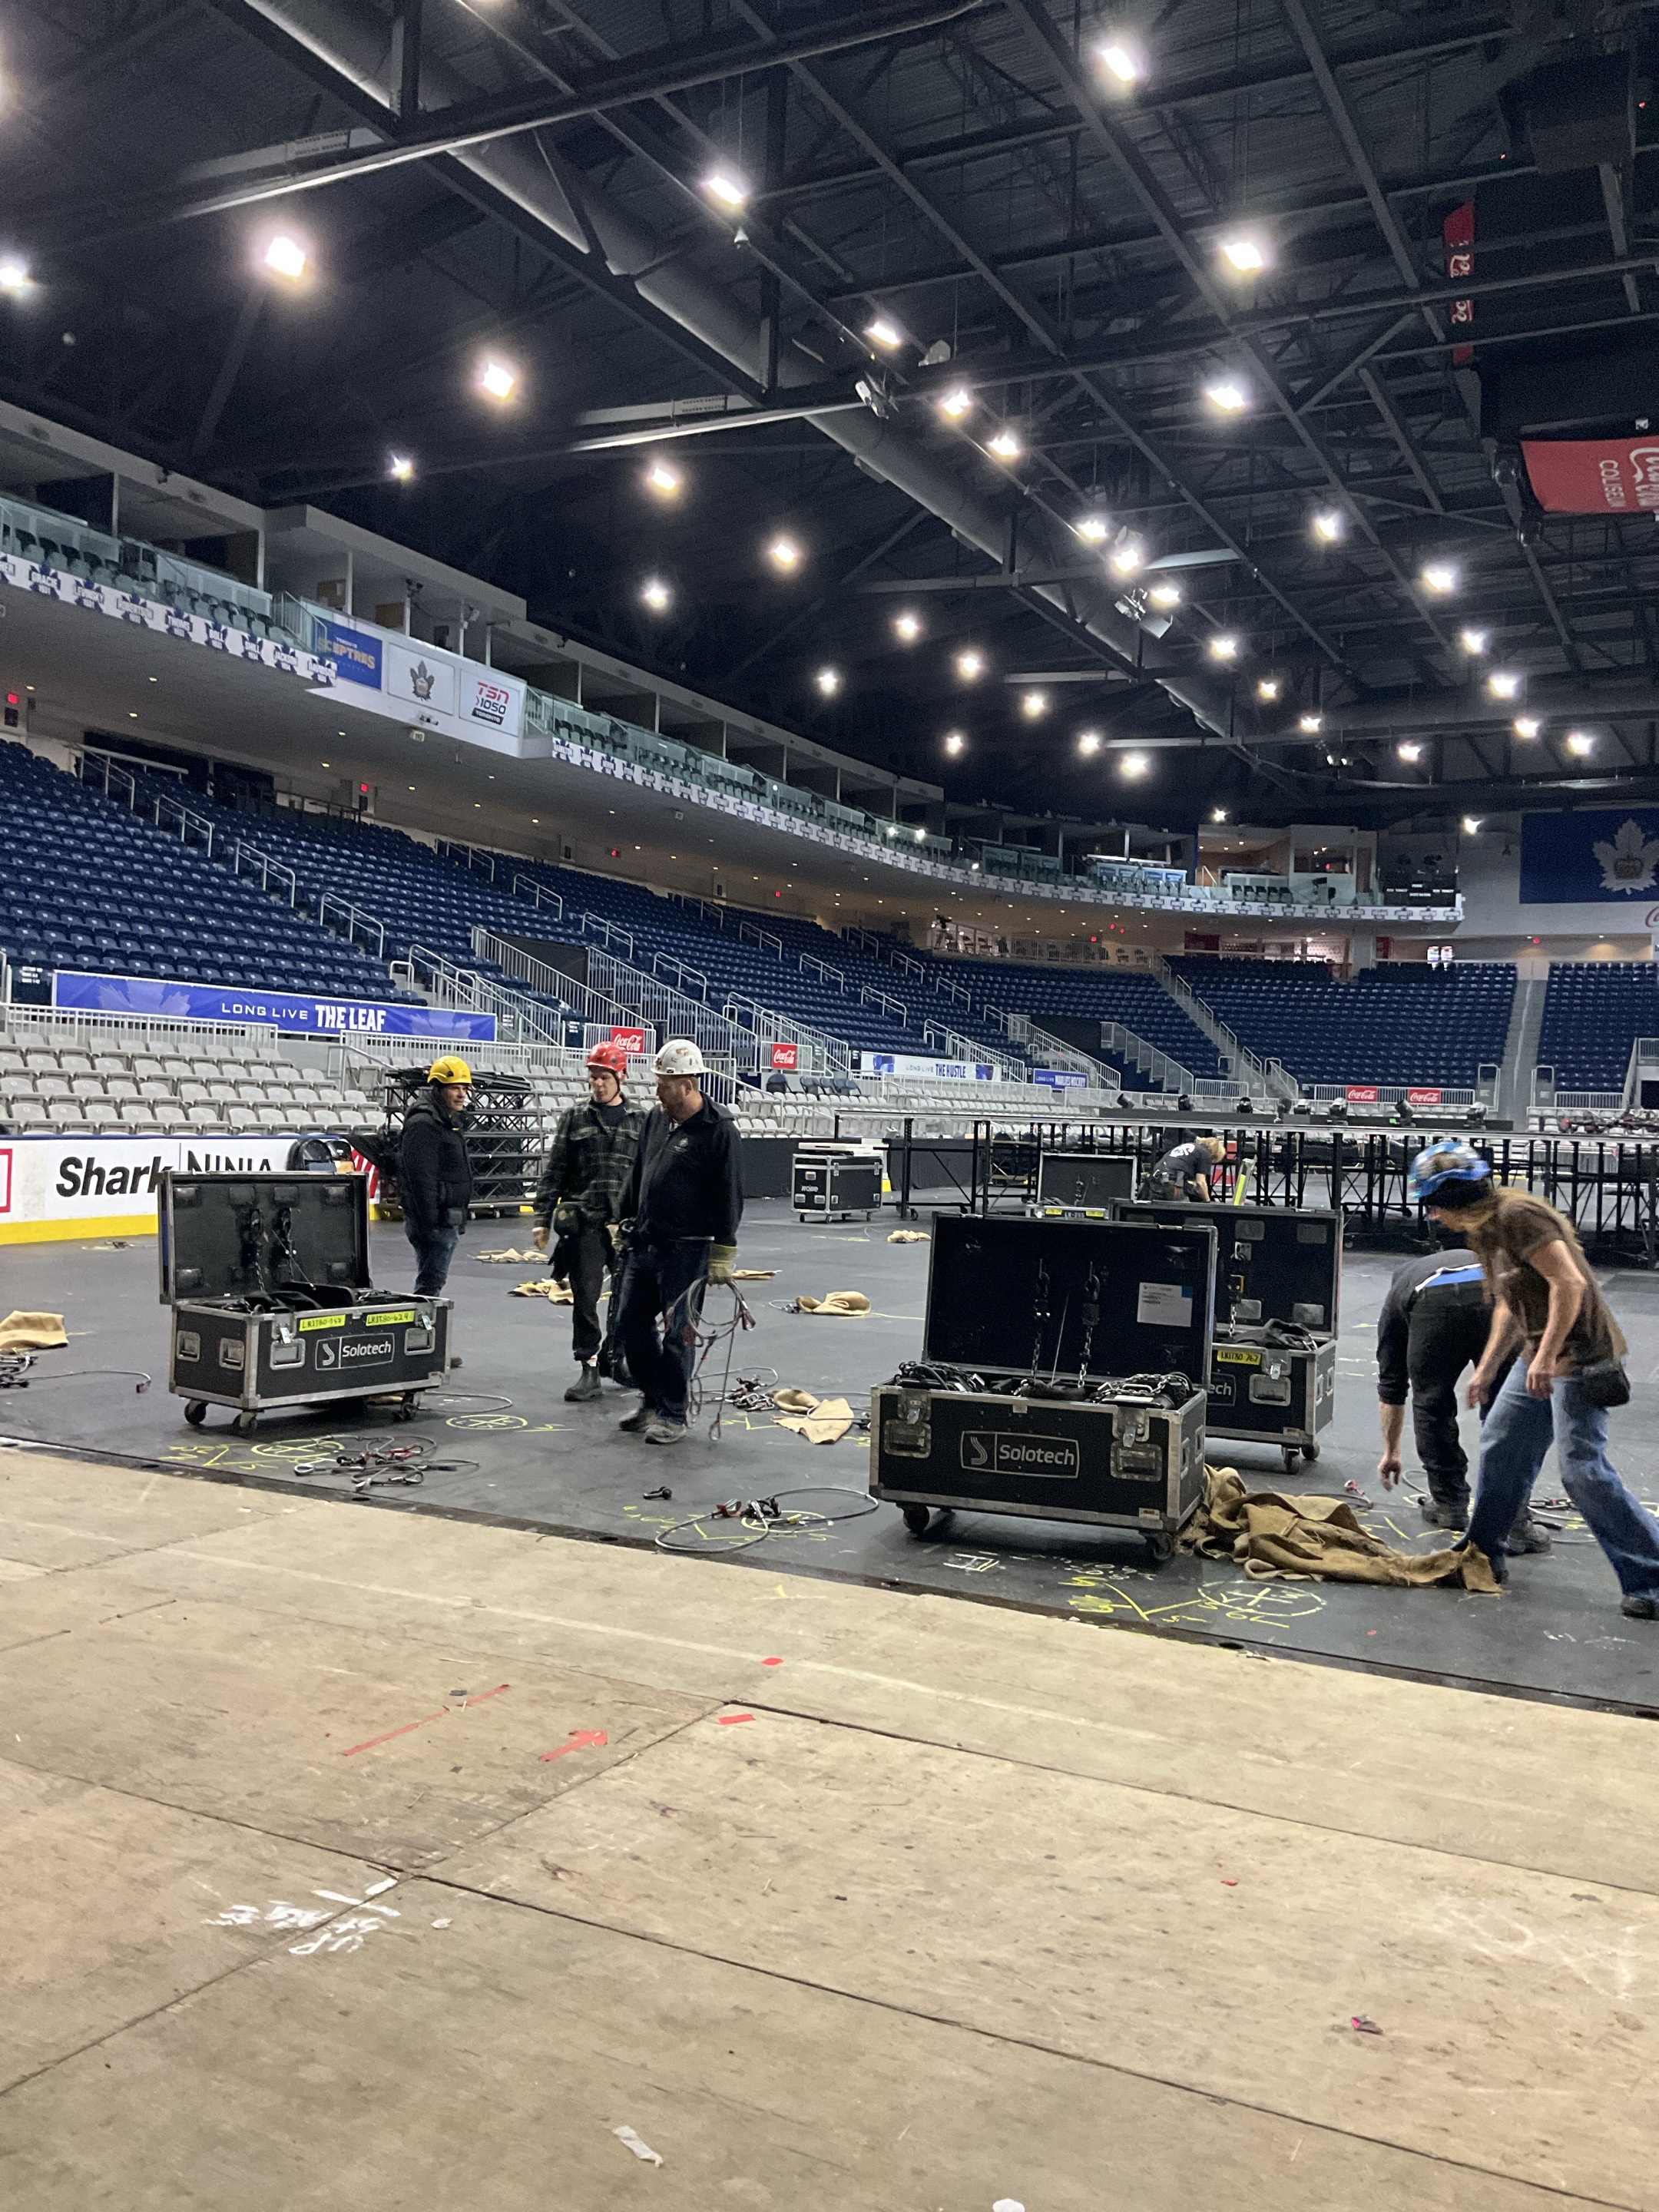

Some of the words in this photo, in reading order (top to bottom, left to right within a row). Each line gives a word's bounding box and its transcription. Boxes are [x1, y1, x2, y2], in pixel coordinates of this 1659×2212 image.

[336, 636, 358, 649] TORONTO
[477, 681, 510, 704] TSN
[479, 697, 506, 715] 1050
[474, 710, 502, 724] TORONTO
[221, 1002, 267, 1017] LONG
[272, 1005, 308, 1021] LIVE
[315, 1005, 346, 1030] THE
[349, 1007, 386, 1032] LEAF
[773, 1049, 796, 1065] Coca-Cola
[935, 1063, 945, 1077] THE
[945, 1064, 966, 1078] HUSTLE
[1348, 1089, 1376, 1100] Coca-Cola
[1409, 1091, 1439, 1103] Coca-Cola
[55, 1155, 174, 1197] Shark
[342, 1340, 391, 1358] Solotech
[998, 1444, 1075, 1465] Solotech
